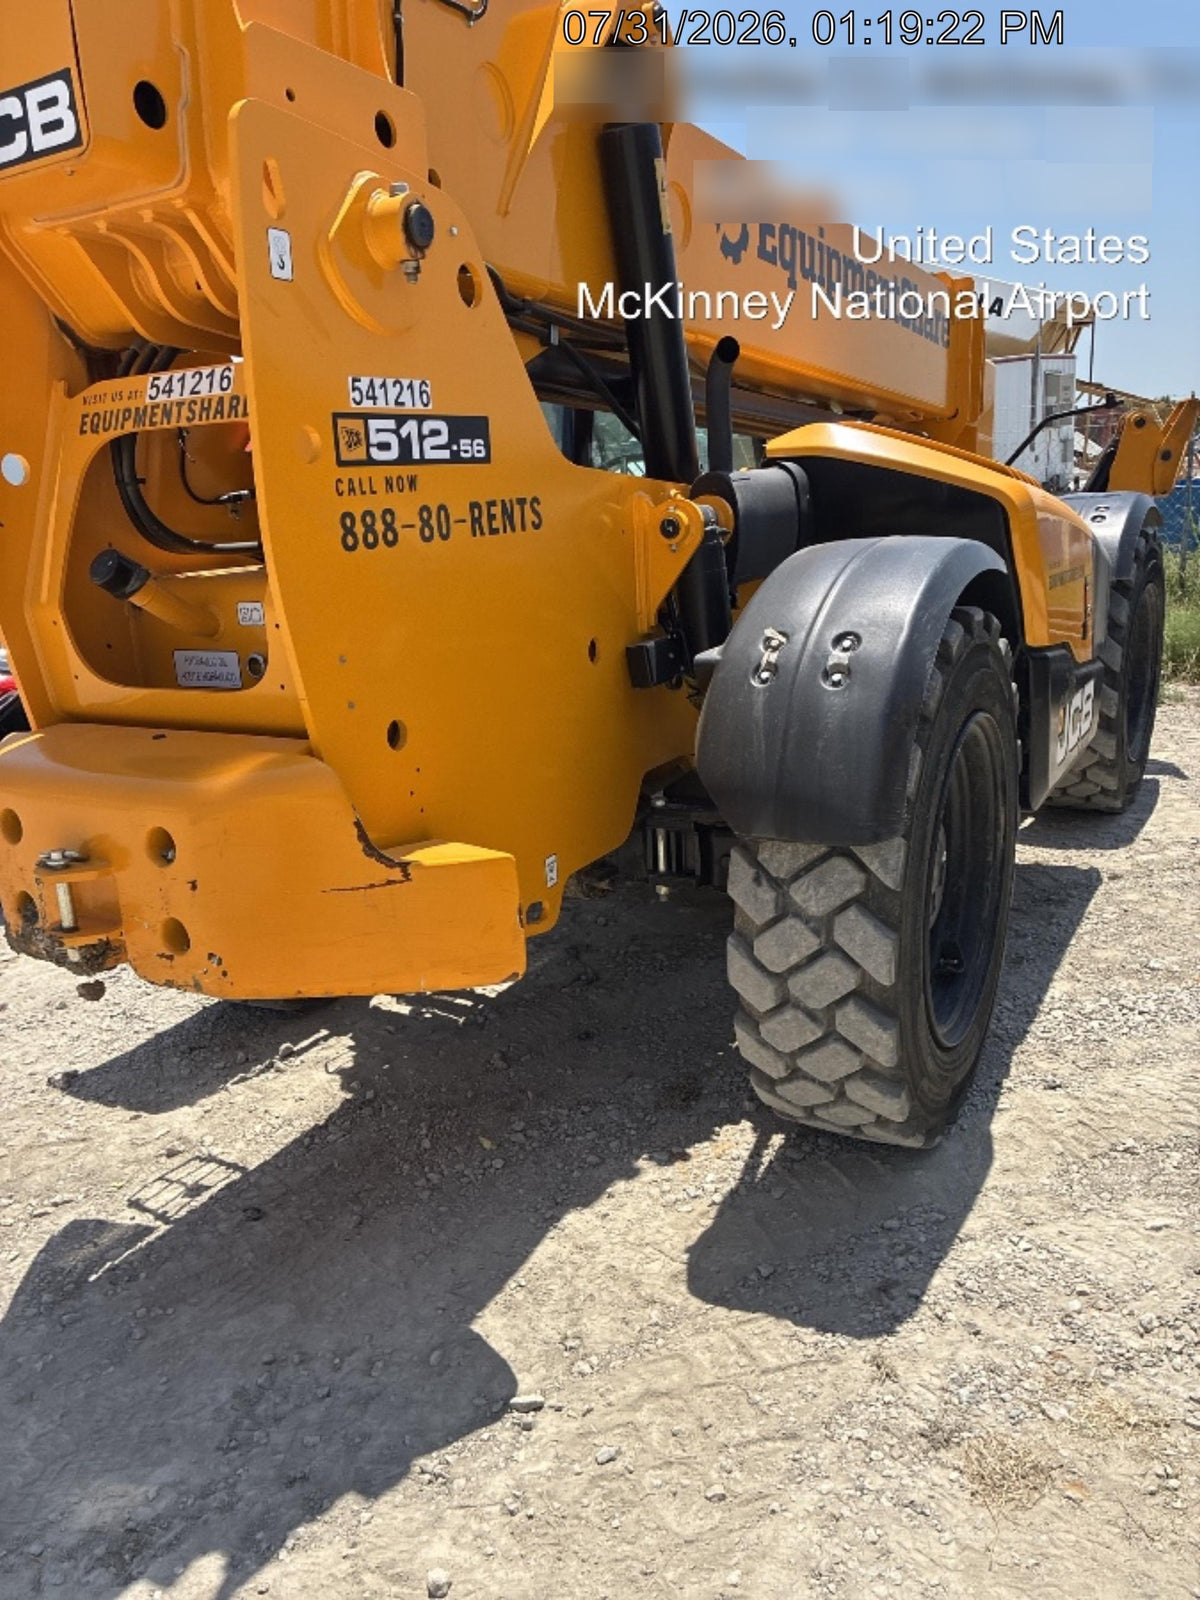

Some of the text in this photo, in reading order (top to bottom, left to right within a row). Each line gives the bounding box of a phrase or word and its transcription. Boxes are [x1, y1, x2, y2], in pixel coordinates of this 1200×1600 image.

[148, 366, 232, 400] 541216
[351, 376, 431, 408] 541216
[335, 474, 419, 497] CALL NOW
[340, 496, 543, 552] 888-80-RENTS
